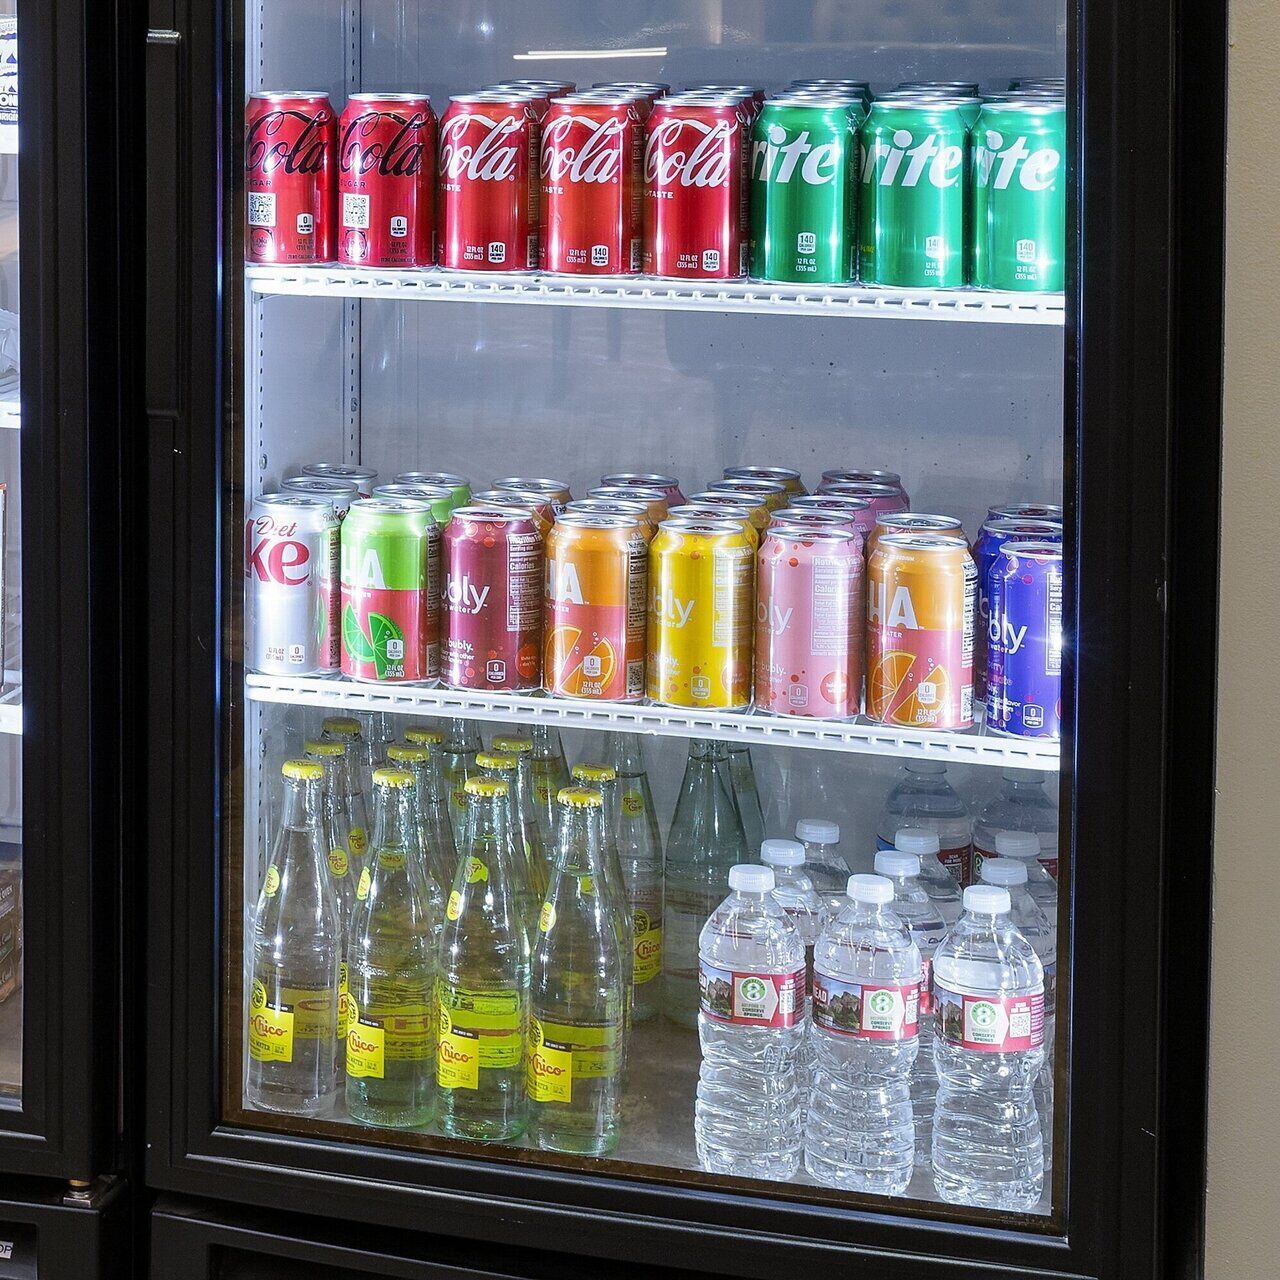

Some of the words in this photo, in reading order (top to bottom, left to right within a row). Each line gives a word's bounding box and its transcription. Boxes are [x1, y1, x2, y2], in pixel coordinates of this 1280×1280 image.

[799, 234, 815, 245] 140
[490, 244, 504, 253] 140
[593, 247, 607, 257] 140
[1018, 240, 1034, 252] 140
[704, 252, 718, 262] 140
[256, 515, 297, 537] Diet
[509, 561, 535, 570] Calories
[254, 1013, 288, 1038] Chico
[348, 1029, 379, 1053] Chico
[439, 1039, 474, 1064] Chico
[531, 1052, 566, 1077] Chico
